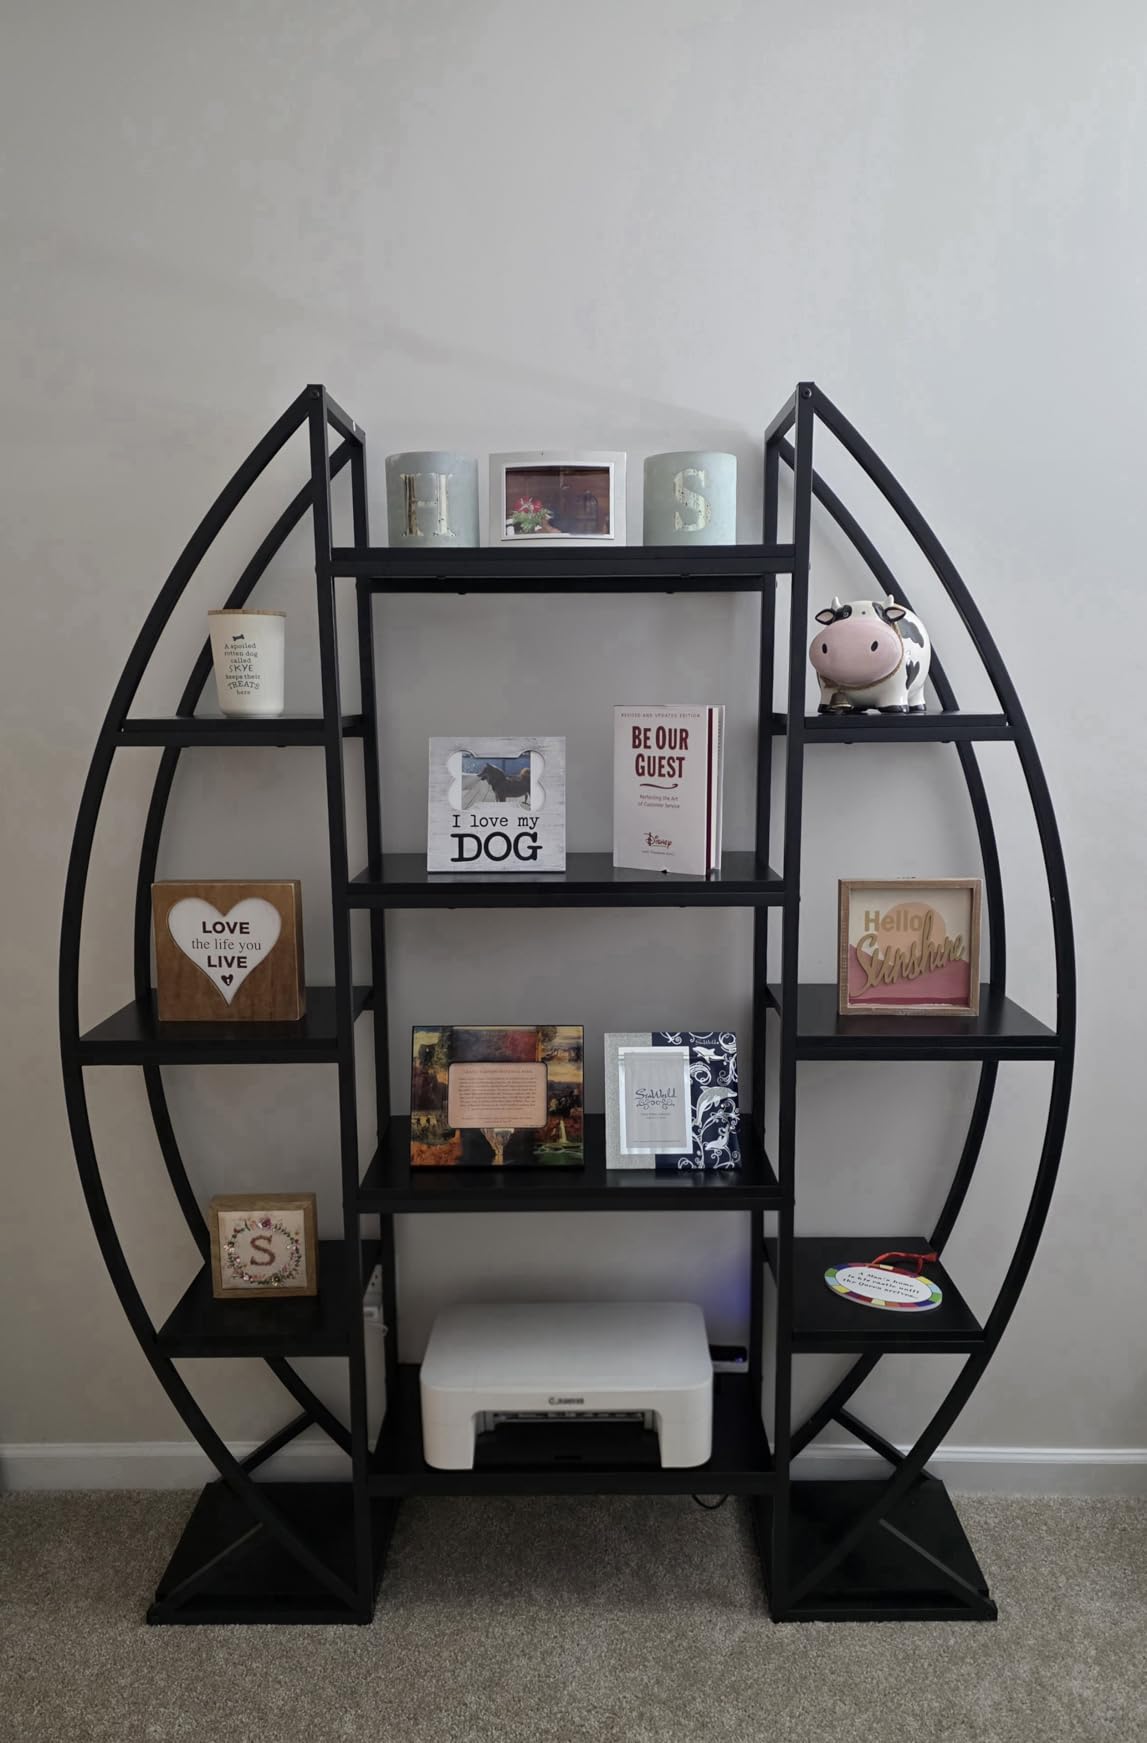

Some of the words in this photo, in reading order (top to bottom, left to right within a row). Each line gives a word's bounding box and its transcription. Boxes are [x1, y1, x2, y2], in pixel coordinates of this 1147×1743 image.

[400, 472, 457, 537] H
[672, 468, 712, 532] S
[229, 664, 254, 672] SKYE
[227, 680, 260, 690] TREATS
[632, 726, 652, 749] BE
[656, 726, 689, 750] OUR
[635, 753, 686, 778] GUEST
[452, 814, 461, 828] I
[470, 814, 509, 828] love
[517, 816, 540, 830] my
[450, 832, 543, 862] DOG
[202, 921, 250, 934] LOVE
[864, 910, 922, 932] Hello
[192, 938, 210, 950] the
[214, 938, 234, 950] life
[239, 941, 262, 953] you
[849, 910, 965, 998] Sunshine
[207, 955, 248, 968] LIVE
[250, 1235, 276, 1266] S
[873, 1280, 897, 1288] castle
[899, 1286, 920, 1294] until
